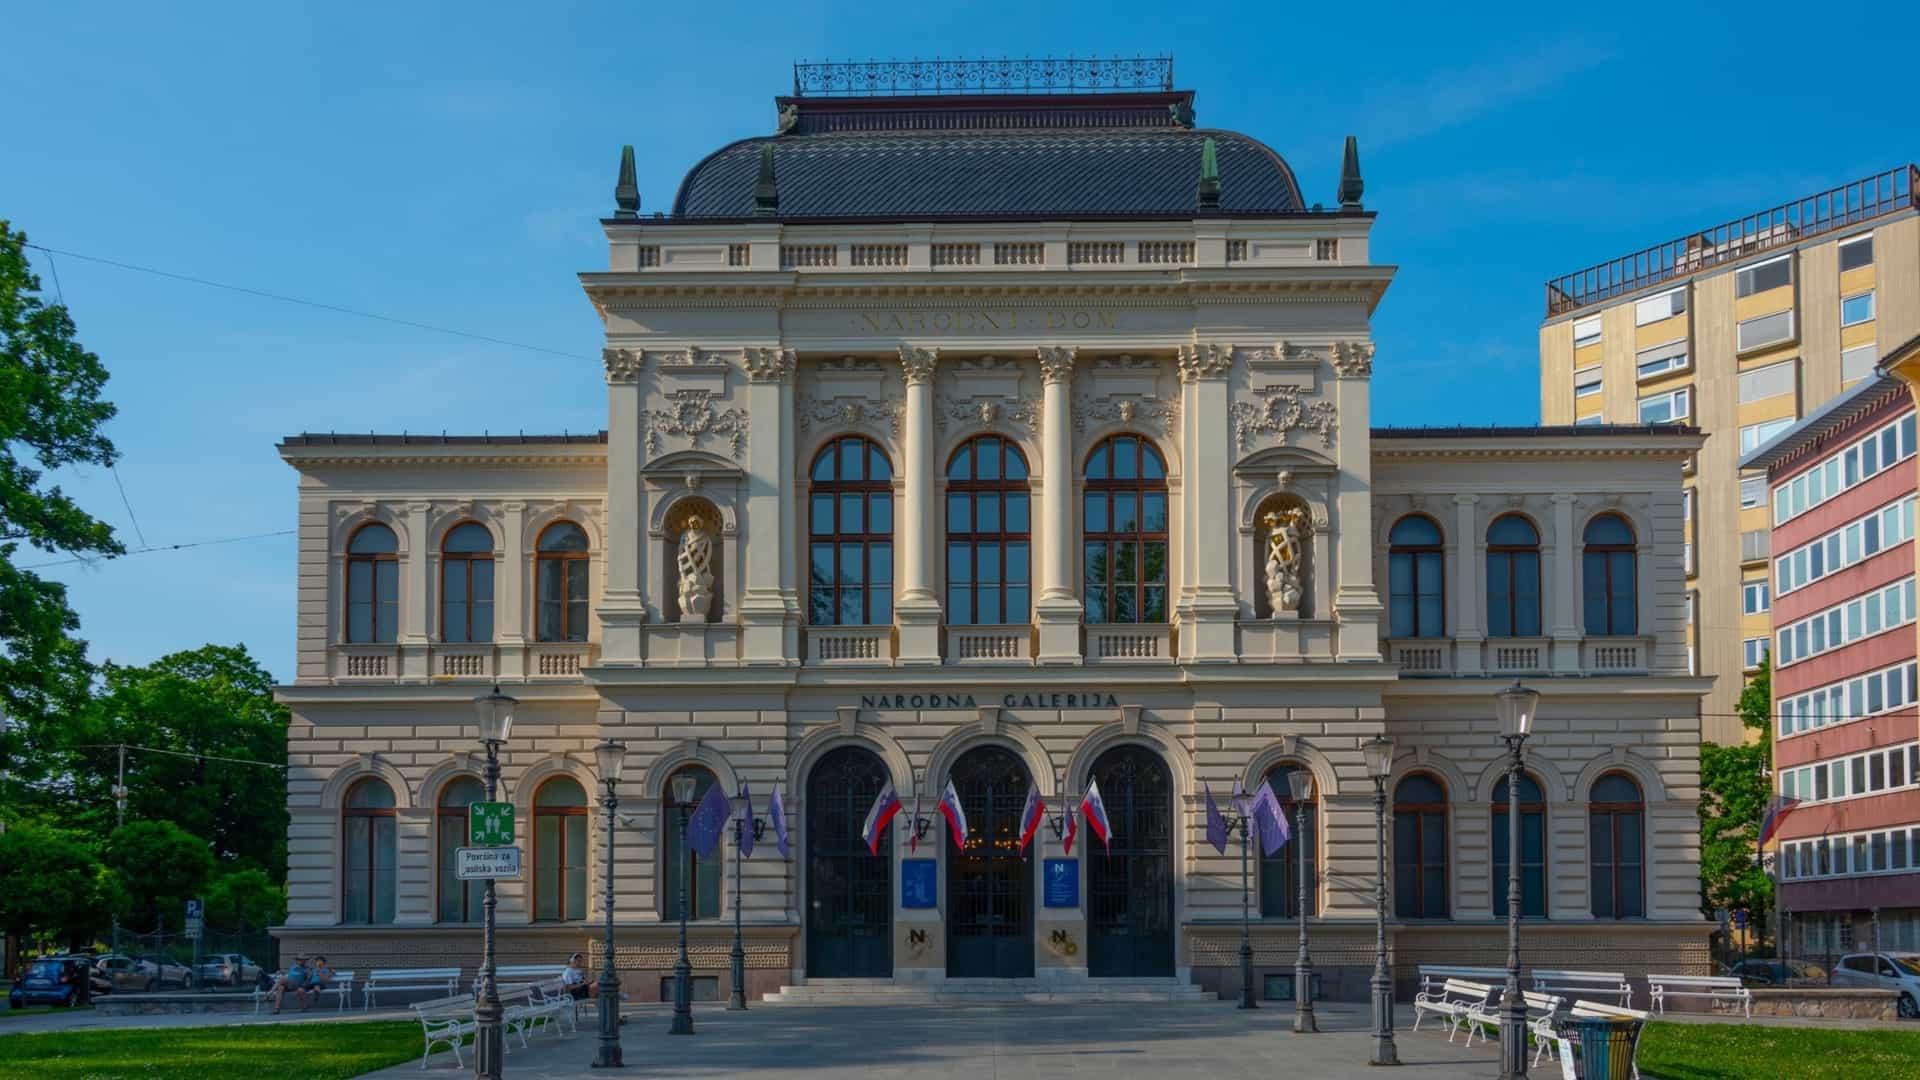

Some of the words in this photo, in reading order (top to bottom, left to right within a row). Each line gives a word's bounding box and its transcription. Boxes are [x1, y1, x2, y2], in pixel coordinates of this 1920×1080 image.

[861, 694, 977, 709] NARODNA
[1003, 693, 1119, 708] GALERIJA
[187, 900, 197, 914] P
